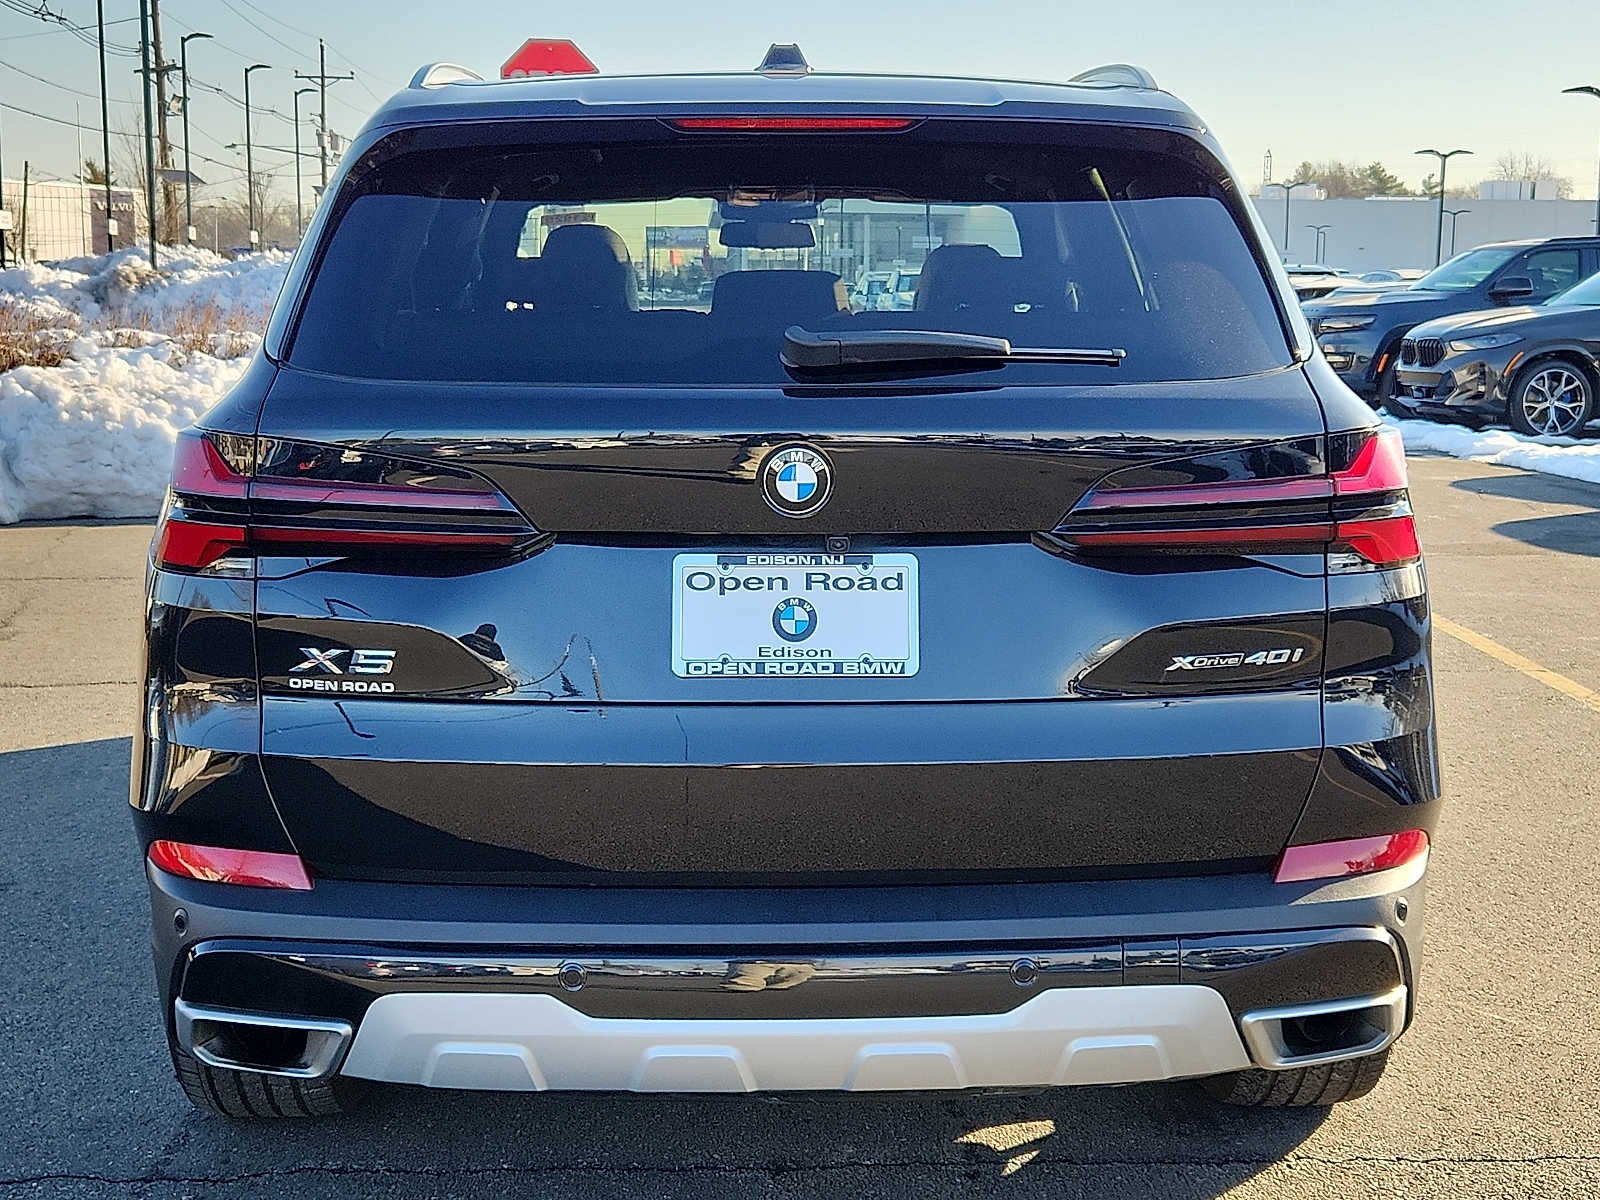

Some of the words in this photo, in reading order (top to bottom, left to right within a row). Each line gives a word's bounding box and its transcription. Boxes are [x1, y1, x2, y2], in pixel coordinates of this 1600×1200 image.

[95, 201, 133, 211] VLVO
[770, 451, 825, 473] BMW
[746, 555, 816, 566] EDISON,
[821, 555, 845, 565] NJ
[685, 571, 789, 596] Open
[805, 572, 904, 591] Road
[777, 598, 813, 612] BMW
[758, 646, 832, 658] Edison
[288, 647, 397, 675] X5
[688, 661, 757, 675] OPEN
[763, 661, 834, 675] ROAD
[842, 661, 905, 675] BMW
[289, 678, 339, 692] OPEN
[341, 680, 395, 693] ROAD
